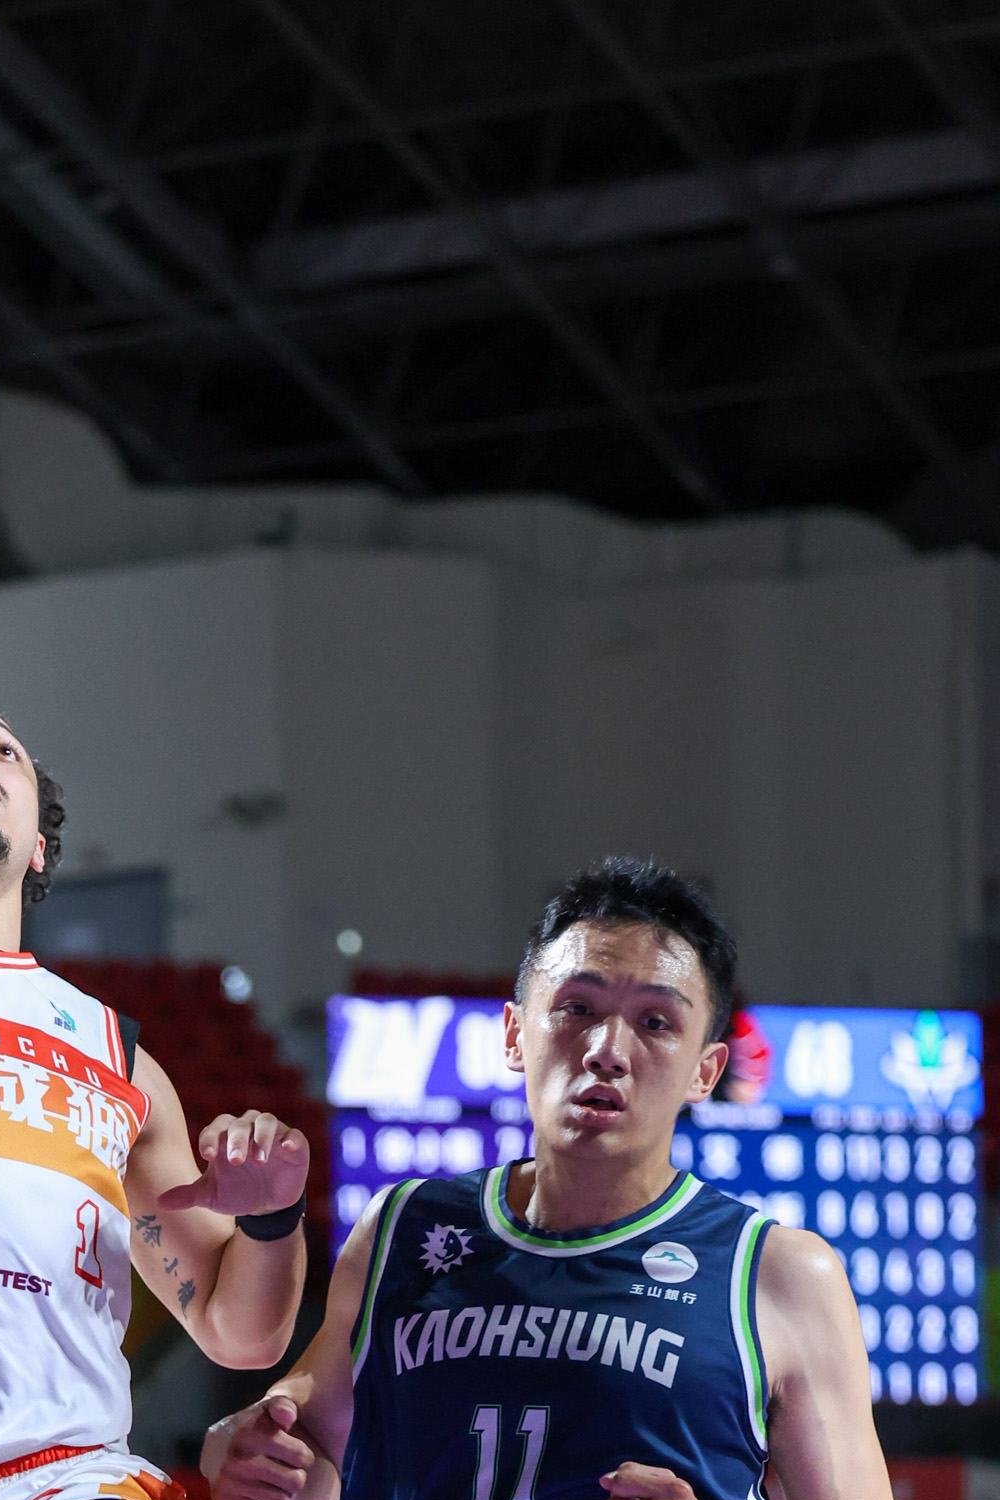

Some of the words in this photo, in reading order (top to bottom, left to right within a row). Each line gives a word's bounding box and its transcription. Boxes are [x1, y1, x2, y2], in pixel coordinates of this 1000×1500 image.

[74, 1199, 102, 1289] 1
[629, 1284, 697, 1305] 玉山銀行
[394, 1305, 685, 1389] KAOHSIUNG
